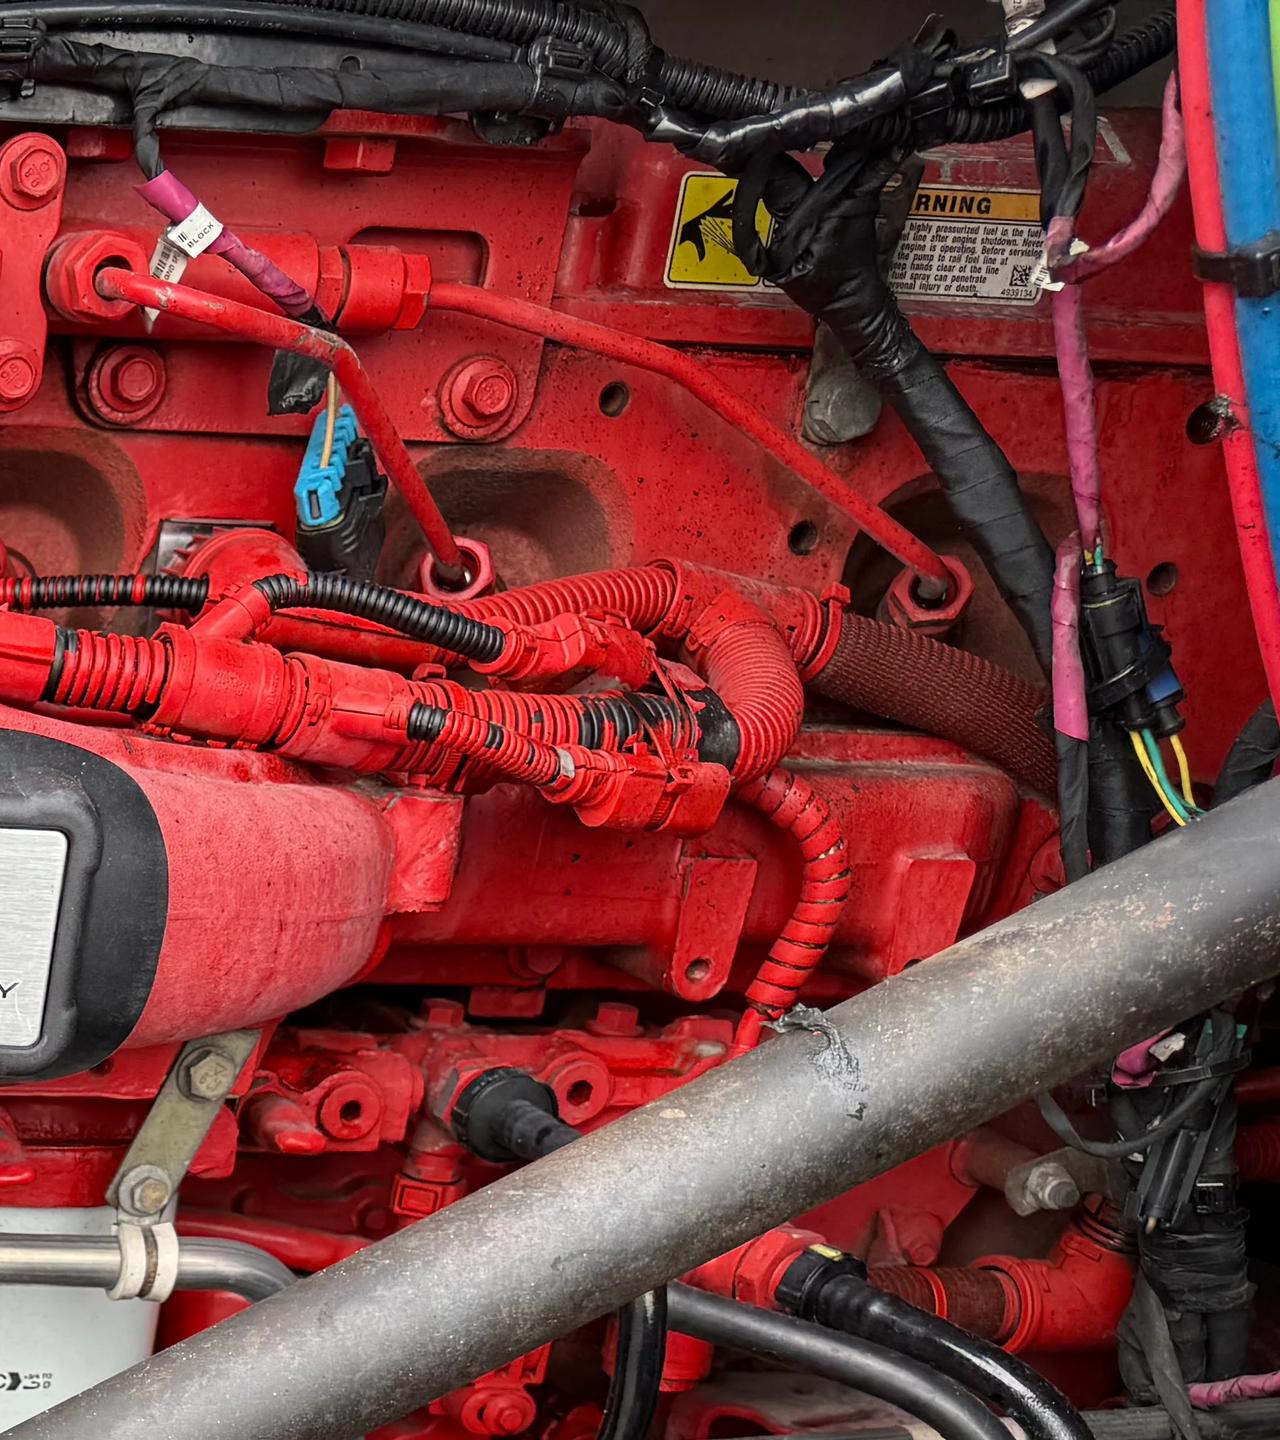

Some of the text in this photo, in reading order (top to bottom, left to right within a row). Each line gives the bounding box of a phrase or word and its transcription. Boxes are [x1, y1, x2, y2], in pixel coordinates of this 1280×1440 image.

[915, 194, 991, 214] RNING
[910, 222, 931, 234] highly
[936, 224, 980, 235] pressurized
[983, 227, 997, 235] fuel
[1012, 228, 1023, 236] the
[913, 233, 926, 241] line
[931, 233, 948, 243] after
[952, 235, 977, 247] engine
[981, 236, 1017, 246] shutdown.
[901, 243, 926, 253] engine
[930, 244, 936, 252] is
[940, 245, 977, 256] operating.
[982, 246, 1005, 255] Before
[913, 254, 934, 264] pump
[949, 254, 961, 263] rail
[966, 255, 979, 264] fuel
[983, 256, 996, 264] line
[910, 263, 932, 272] hands
[937, 263, 955, 272] clear
[959, 264, 967, 273] of
[970, 265, 981, 274] the
[985, 266, 999, 275] line
[910, 273, 930, 283] spray
[951, 274, 986, 284] penetrate
[919, 282, 940, 292] injury
[956, 283, 978, 292] death.
[1001, 288, 1033, 297] 4939134
